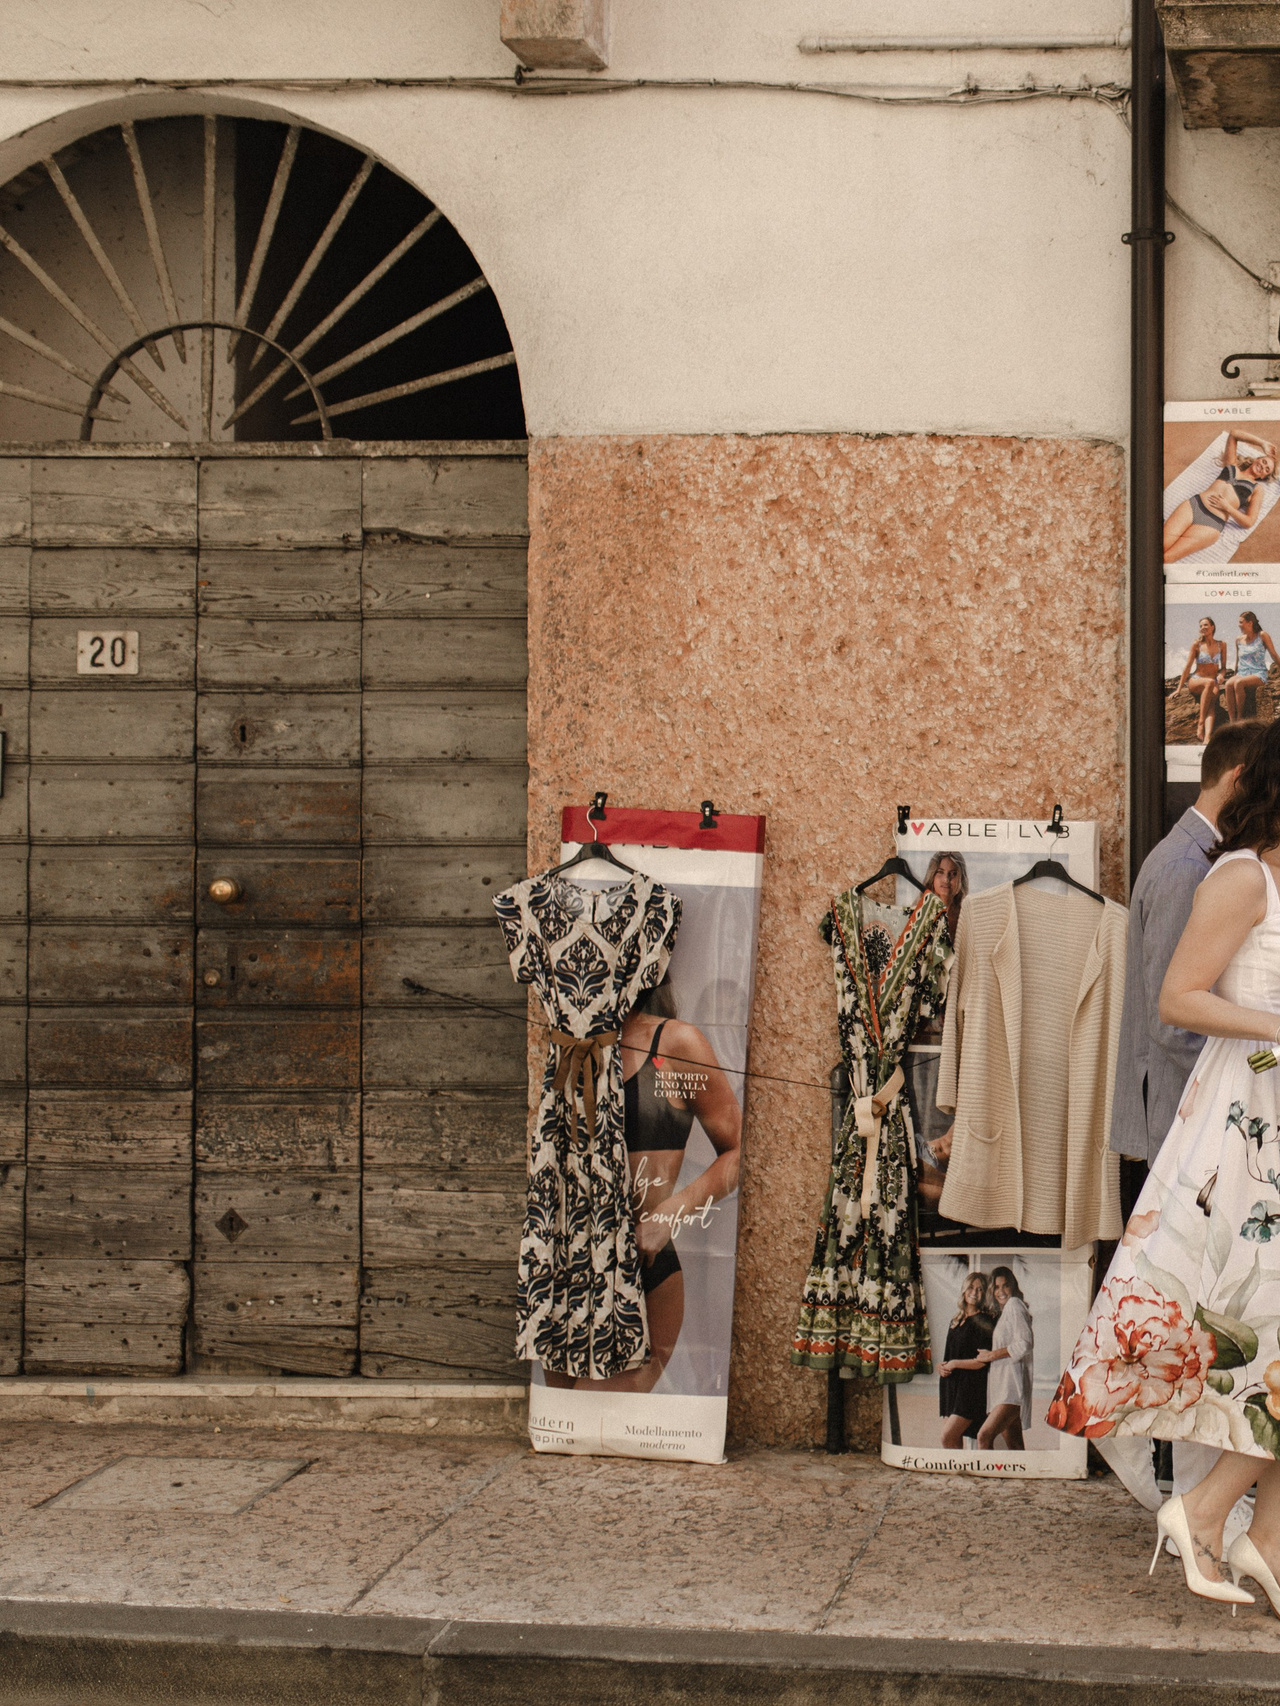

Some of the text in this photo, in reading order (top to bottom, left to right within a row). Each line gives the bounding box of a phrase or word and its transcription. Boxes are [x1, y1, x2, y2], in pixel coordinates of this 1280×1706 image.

[89, 636, 126, 668] 20
[654, 1071, 709, 1081] SUPPORTO
[654, 1080, 707, 1091] FINO ALLA
[653, 1089, 697, 1099] COPPA E
[639, 1194, 721, 1240] comfort
[530, 1416, 574, 1432] odern
[624, 1424, 703, 1439] Modellamento
[639, 1440, 686, 1451] moderno
